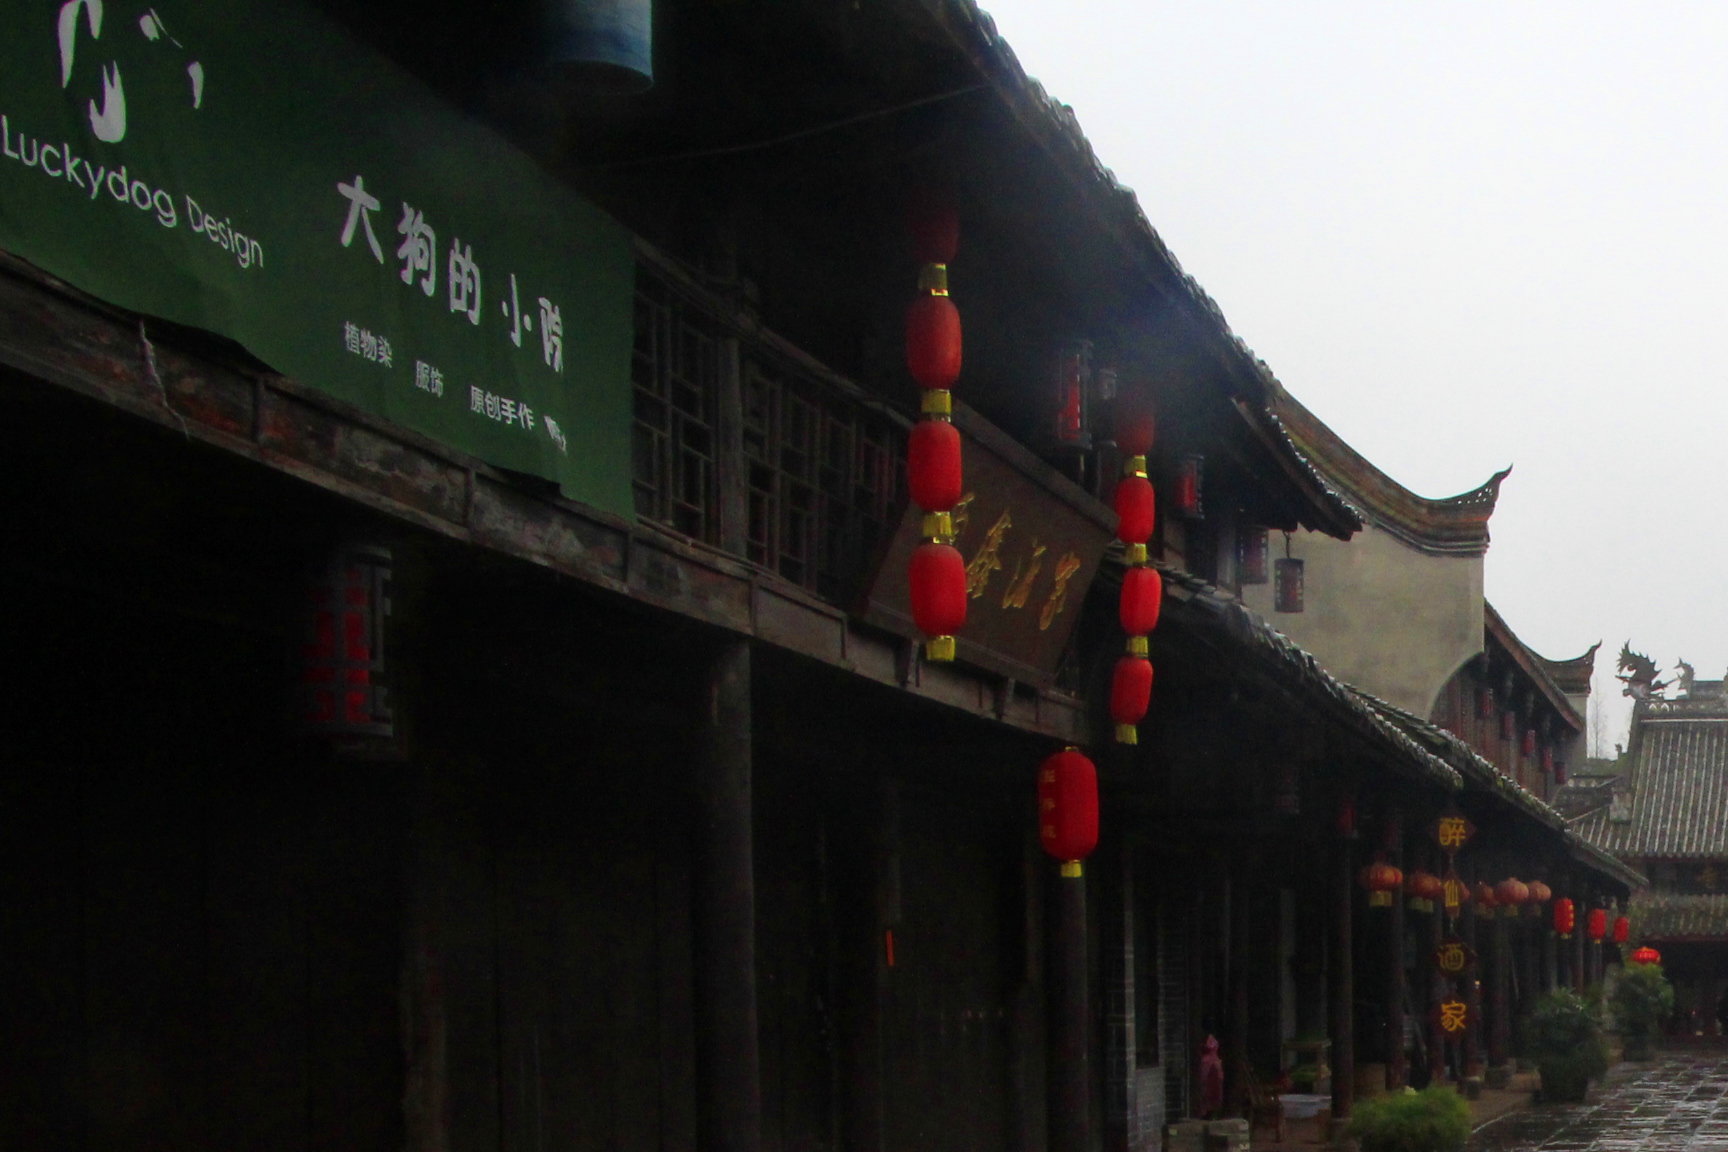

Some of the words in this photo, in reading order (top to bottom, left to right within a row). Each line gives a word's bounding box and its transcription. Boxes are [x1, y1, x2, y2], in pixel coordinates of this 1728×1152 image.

[1, 114, 177, 228] Luckydog
[186, 194, 264, 268] Design
[344, 320, 393, 369] 植物染
[415, 360, 444, 398] 服饰
[470, 384, 535, 431] 原创手作
[1437, 816, 1467, 1032] 醉仙酒家
